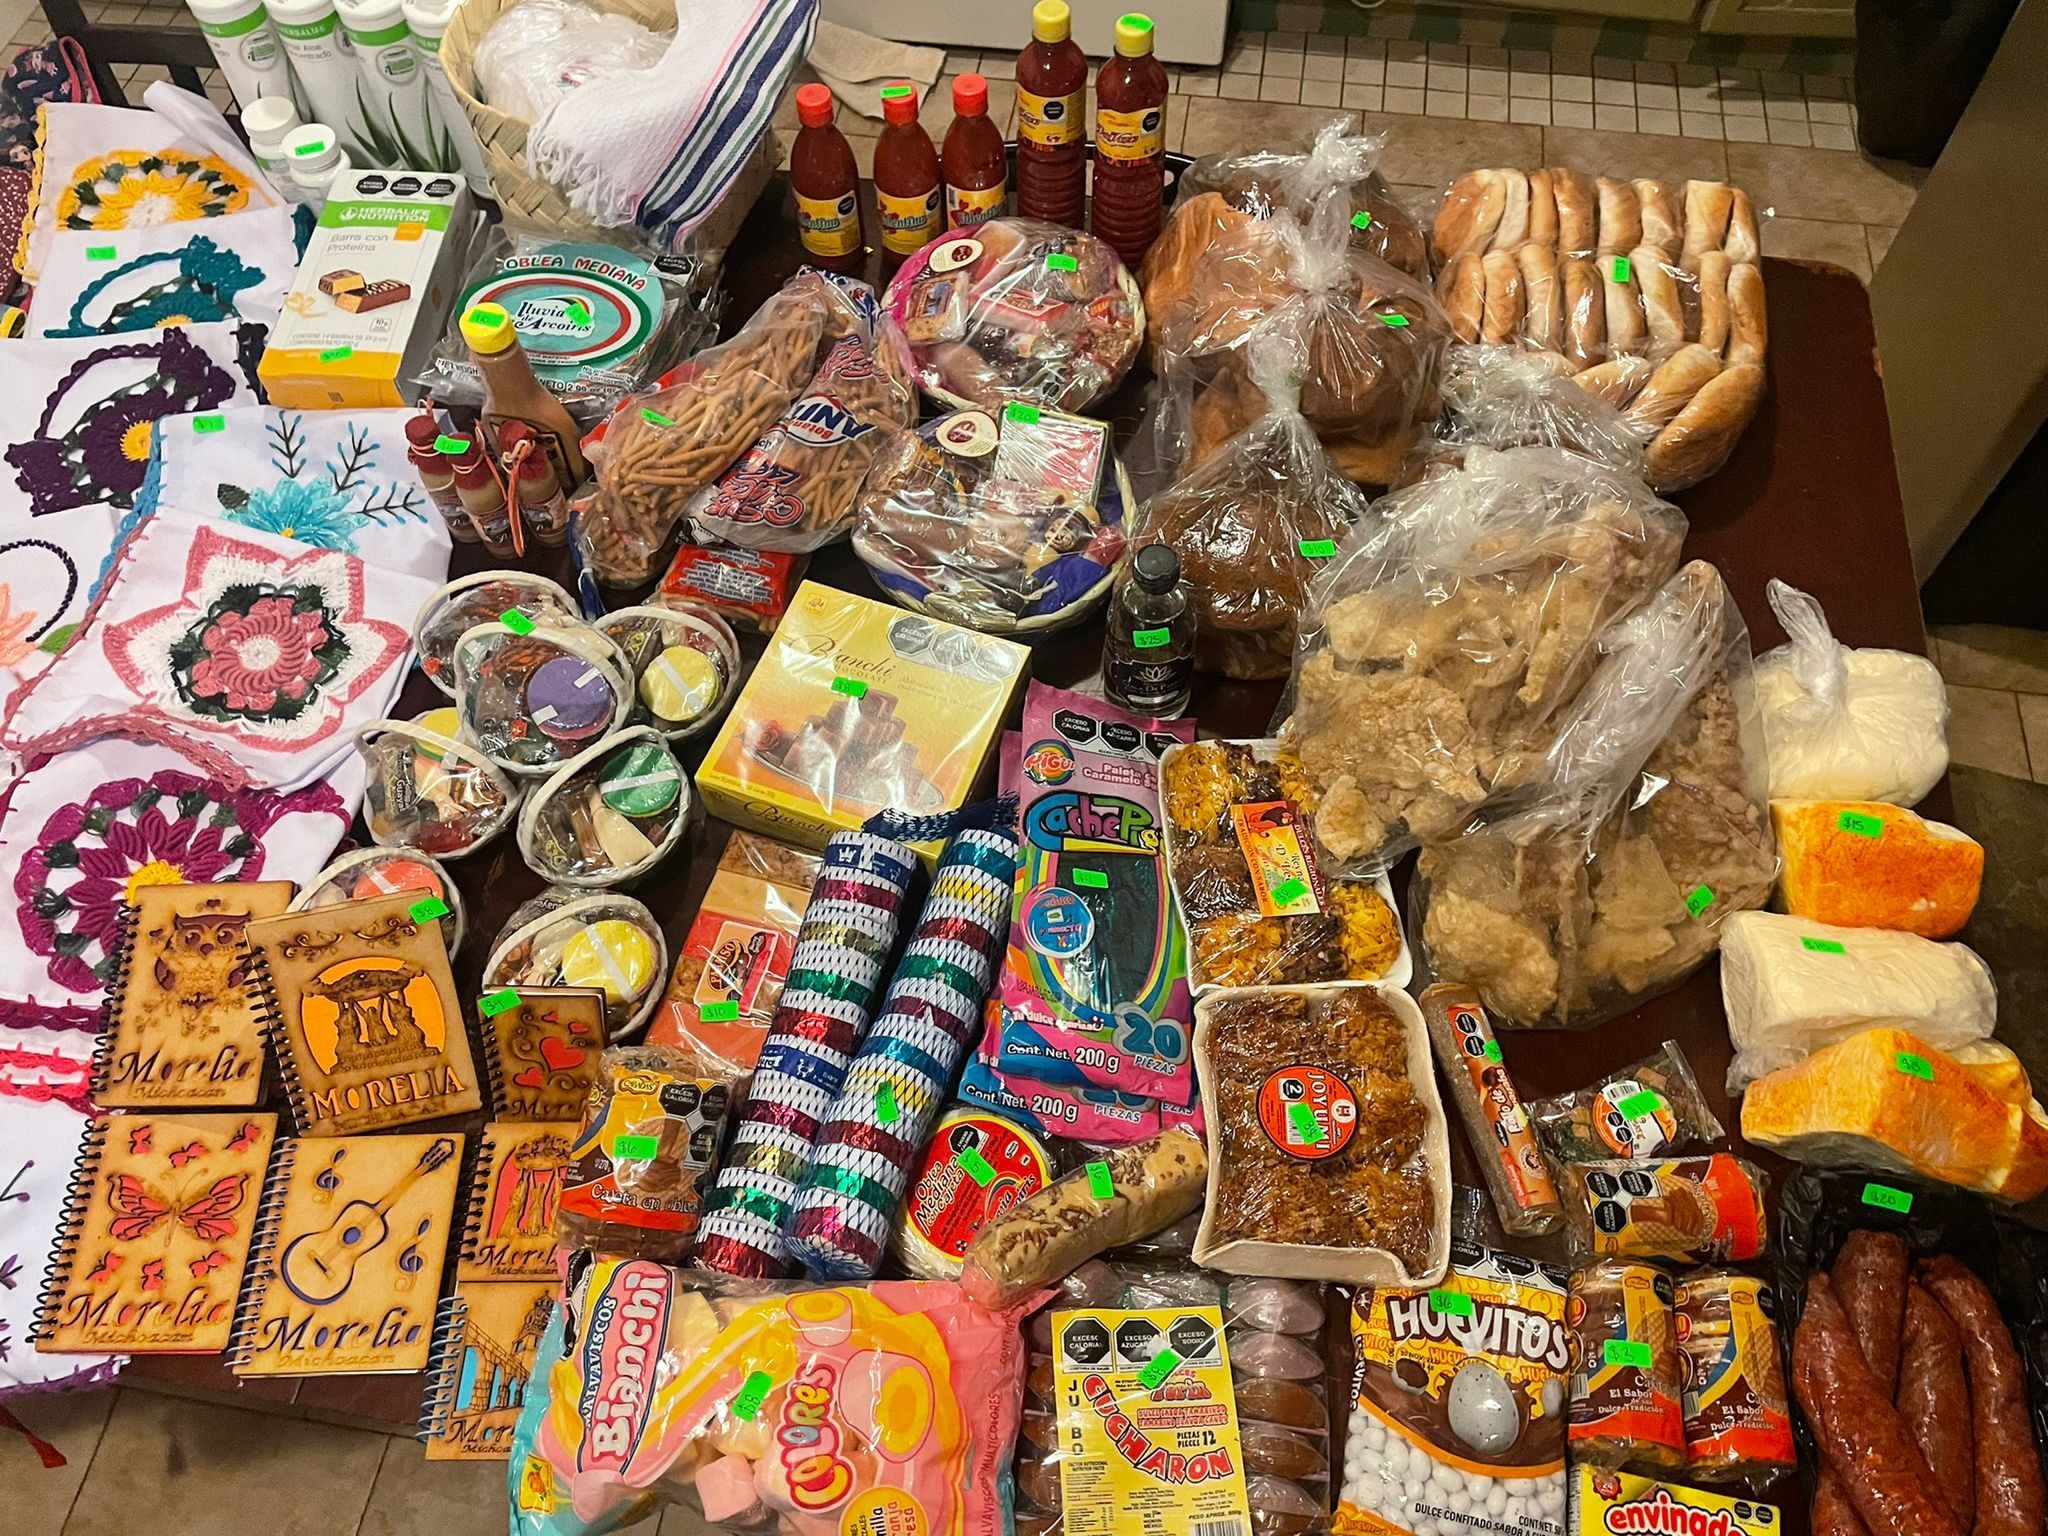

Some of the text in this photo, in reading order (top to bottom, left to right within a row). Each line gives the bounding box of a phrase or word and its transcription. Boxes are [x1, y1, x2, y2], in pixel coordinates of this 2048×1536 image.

[357, 214, 429, 223] NUTRITION
[359, 207, 431, 216] HERBALIFE
[504, 256, 648, 290] OBLEA MEDIANA
[791, 401, 876, 438] ANI
[788, 633, 897, 676] Bianchi
[1083, 767, 1141, 785] Caramelo
[1118, 1009, 1186, 1064] 20
[113, 1045, 256, 1088] Morelia
[1007, 1043, 1121, 1074] Cont. Net. 200 g
[1135, 1055, 1177, 1076] PIEZAS
[312, 1064, 465, 1121] MORELIA
[965, 1085, 1079, 1123] Cont. Net. 200 g
[1288, 1083, 1303, 1097] 2
[1095, 1103, 1142, 1124] PIEZAS
[1161, 1103, 1194, 1116] EZAS
[591, 1183, 638, 1207] Cajeta
[642, 1198, 661, 1210] en
[915, 1161, 942, 1201] Oblea
[915, 1155, 960, 1236] Mediana
[938, 1169, 965, 1212] Cajeta
[60, 1286, 230, 1330] Morelia
[256, 1306, 427, 1356] Morelia
[591, 1271, 668, 1462] Bianchi
[1609, 1388, 1653, 1400] El Sabor
[1722, 1405, 1765, 1416] El Sabor
[1082, 1374, 1234, 1485] CUCHARON
[1202, 1429, 1217, 1446] 12
[1415, 1503, 1442, 1520] DULCE
[1444, 1510, 1493, 1531] CONFITADO
[1493, 1522, 1524, 1536] SABOR
